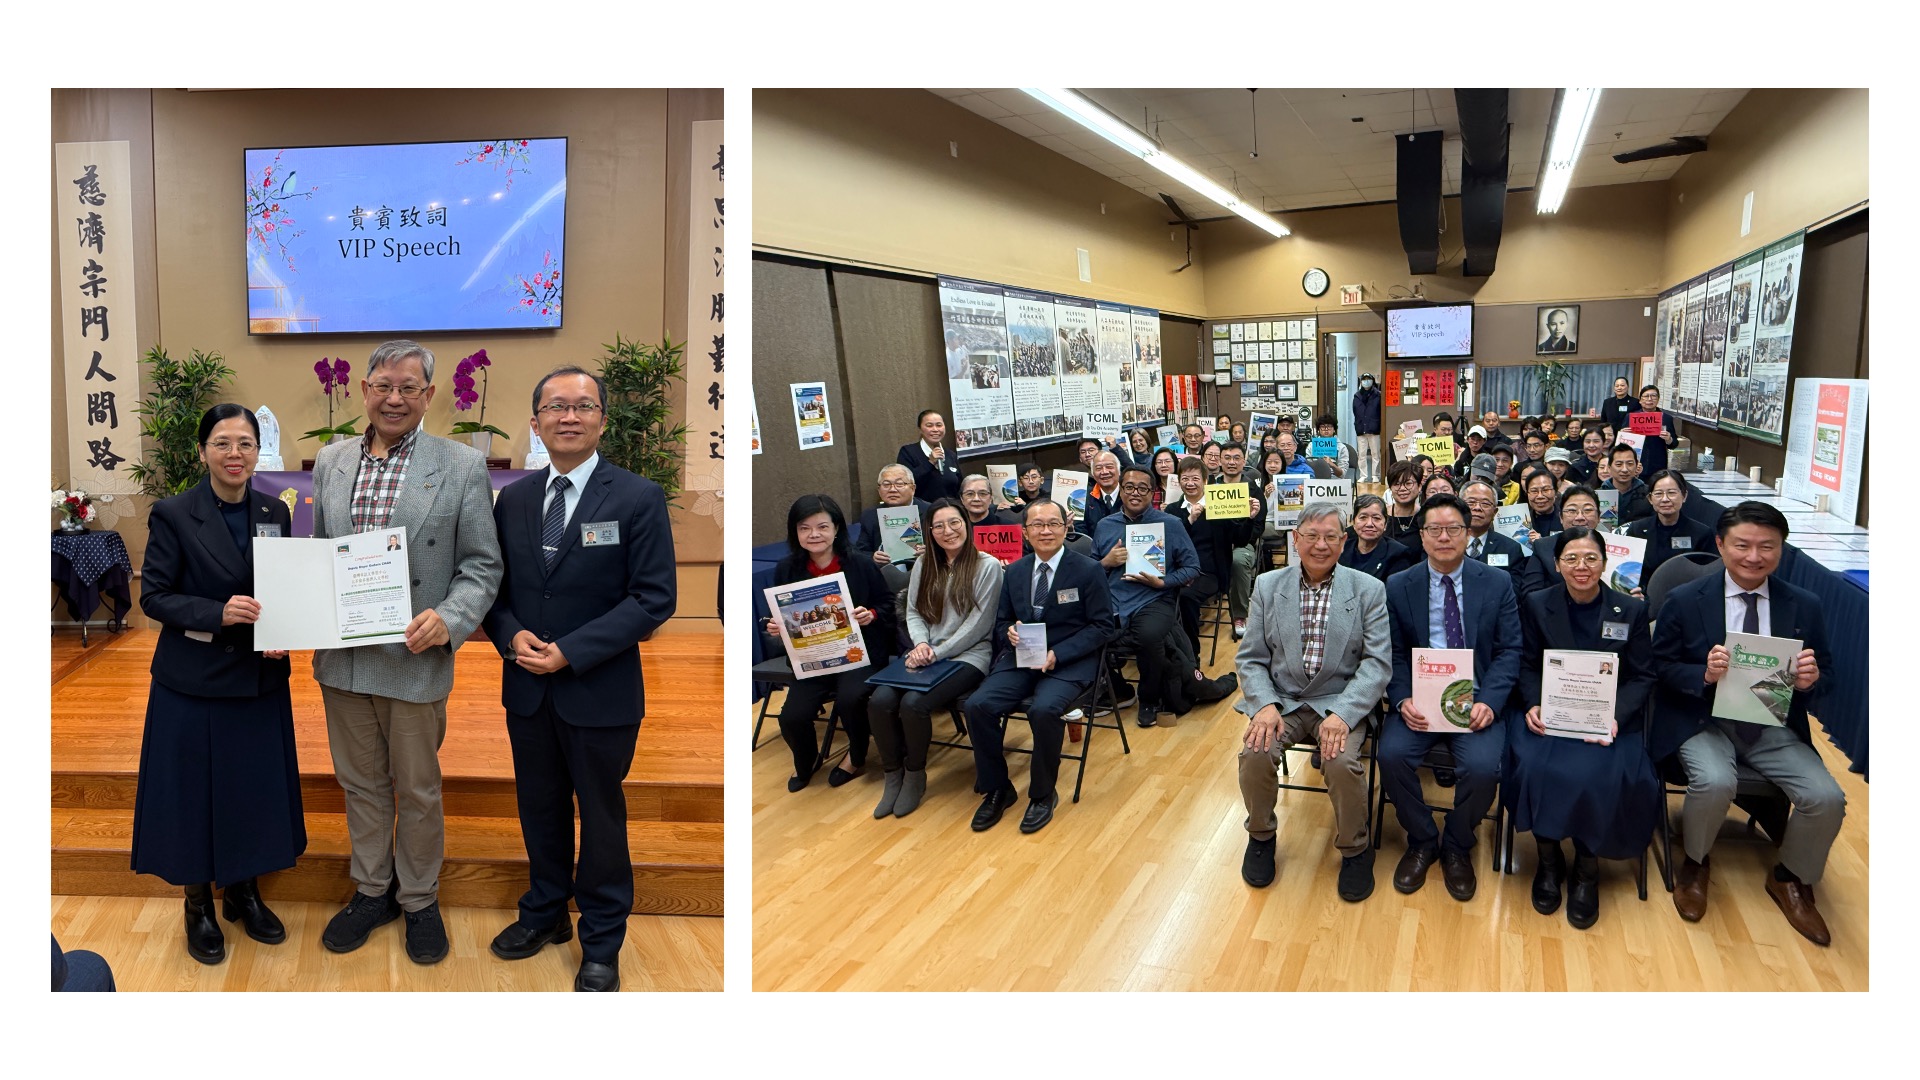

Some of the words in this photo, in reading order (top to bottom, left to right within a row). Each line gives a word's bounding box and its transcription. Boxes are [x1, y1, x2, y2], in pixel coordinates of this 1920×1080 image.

[348, 205, 447, 231] 貴賓致詞
[338, 238, 376, 259] VIP
[383, 236, 461, 263] Speech
[1343, 292, 1359, 304] EXIT
[73, 165, 126, 471] 慈濟宗門人間路
[1423, 331, 1445, 339] Speech
[1086, 413, 1118, 423] TCML
[1632, 416, 1661, 424] TCML
[1420, 441, 1450, 452] TCML
[1208, 489, 1245, 500] TCML
[1308, 486, 1347, 497] TCML
[978, 532, 1018, 544] TCML
[802, 620, 831, 631] WELCOME
